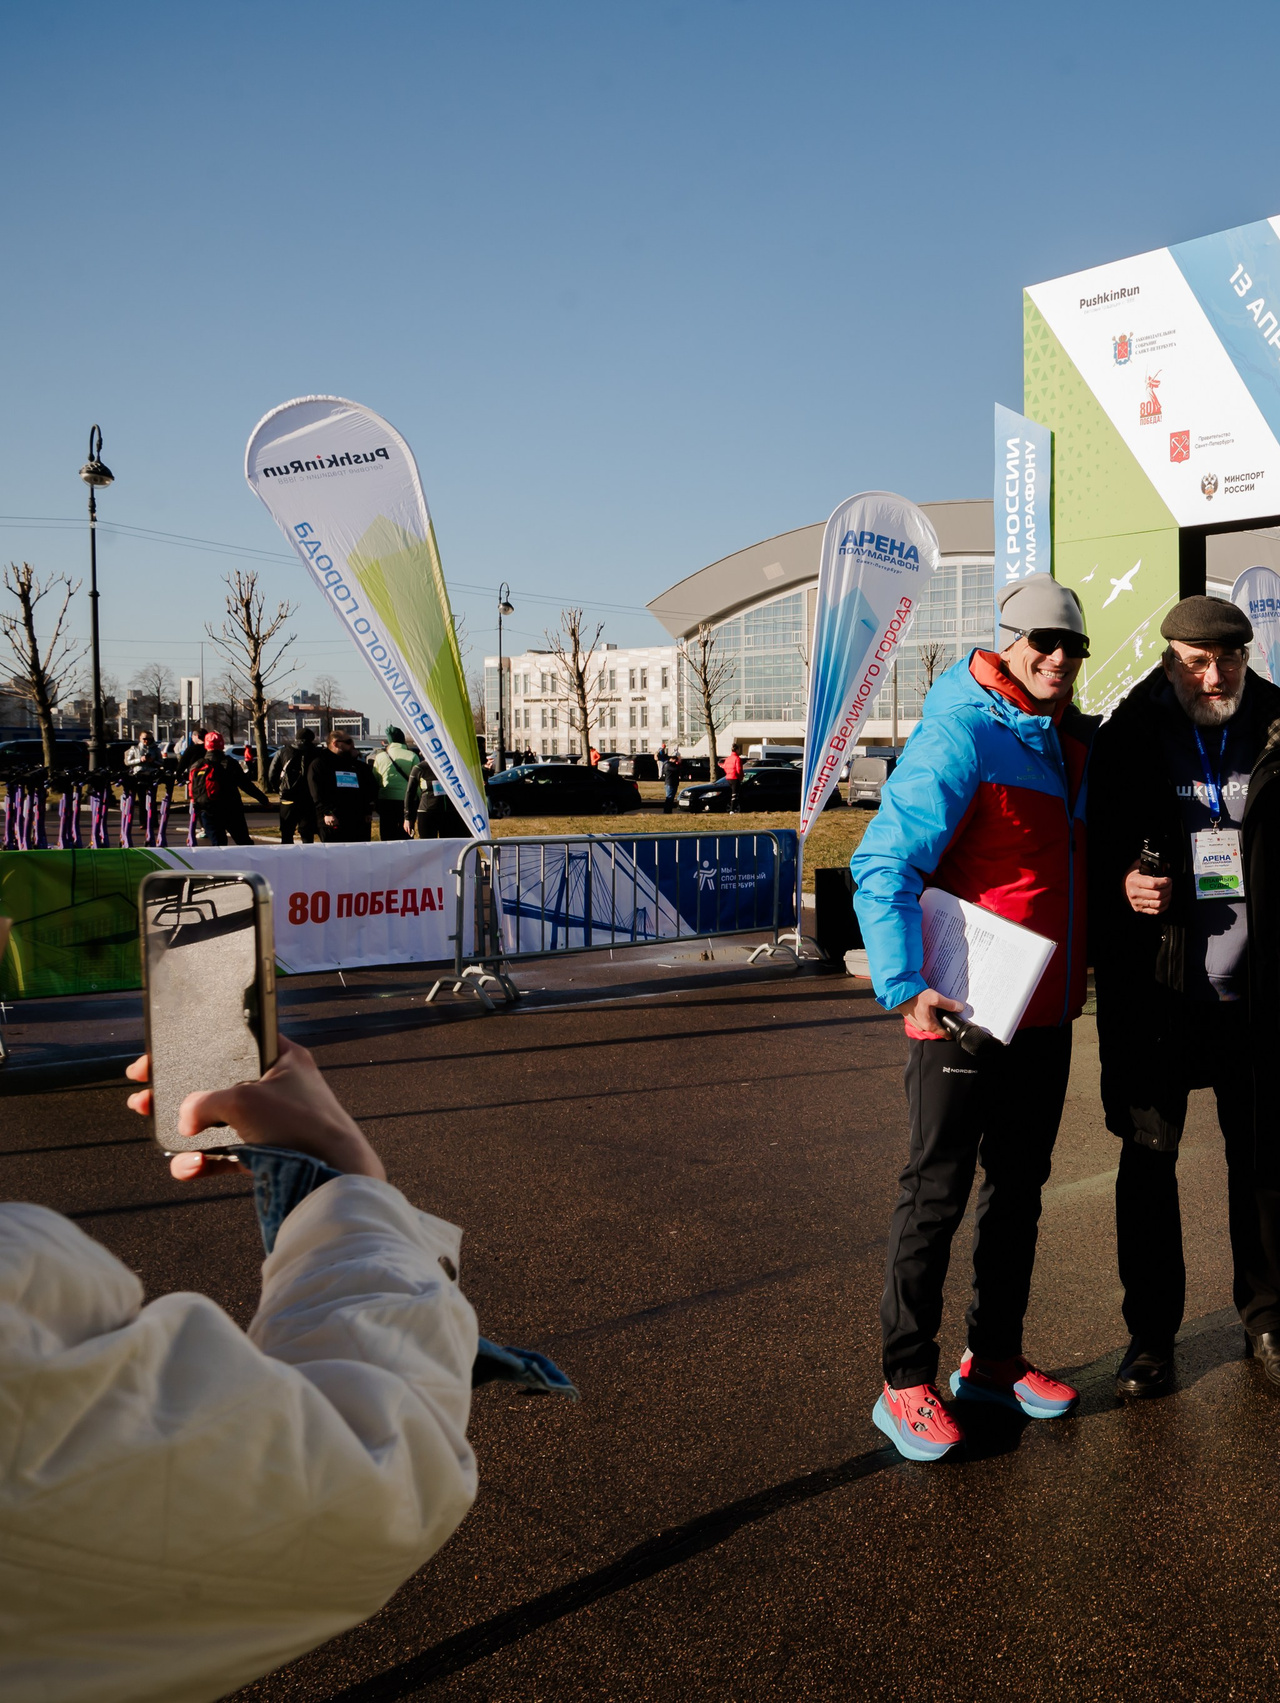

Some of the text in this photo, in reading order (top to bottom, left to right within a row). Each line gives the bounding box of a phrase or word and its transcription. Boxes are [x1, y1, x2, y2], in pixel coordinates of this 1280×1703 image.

[1229, 263, 1253, 298] 13
[1079, 285, 1140, 309] PushkinRun
[1224, 471, 1265, 484] МИНСПОРТ
[1224, 483, 1255, 494] РОССИИ
[1005, 437, 1021, 554] РОССИИ
[838, 547, 920, 573] ПОЛУМАРАФОН
[840, 529, 920, 564] АРЕНА
[830, 663, 881, 752] Великого
[875, 596, 913, 663] города
[1202, 854, 1231, 862] АРЕНА
[288, 887, 444, 926] 80 ПОБЕДА!
